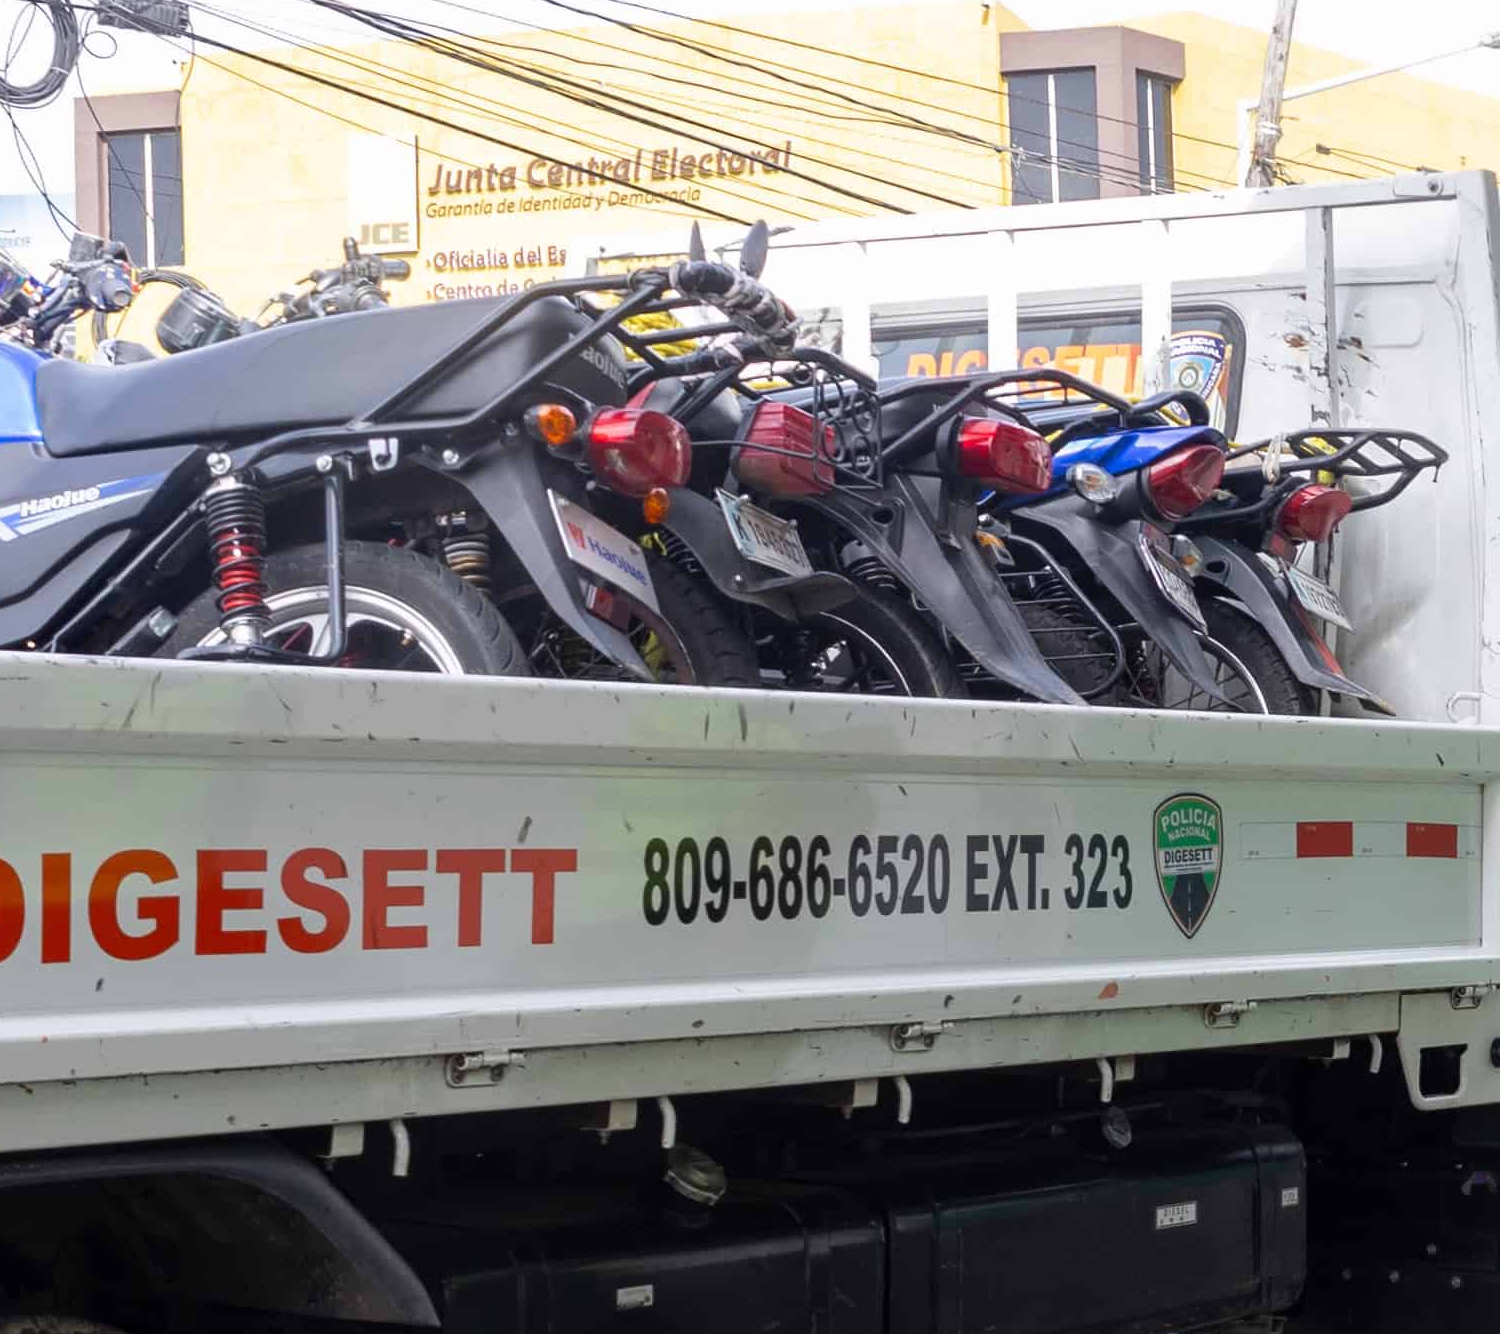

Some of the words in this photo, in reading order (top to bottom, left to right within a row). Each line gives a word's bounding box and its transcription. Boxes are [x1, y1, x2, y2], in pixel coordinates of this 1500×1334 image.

[427, 164, 517, 196] Junta
[527, 148, 643, 187] Central
[651, 140, 791, 180] Electoral
[497, 197, 516, 214] de
[519, 193, 593, 212] Identidad
[607, 186, 701, 207] Democracia
[359, 222, 409, 245] JCE
[514, 246, 543, 268] del
[19, 486, 100, 517] Haojue
[1161, 807, 1216, 833] POLICIA
[1167, 826, 1211, 843] NACIONAL
[1164, 847, 1213, 864] DIGESETT
[643, 834, 951, 927] 809-686-6520
[965, 834, 1050, 912] EXT.
[1063, 832, 1133, 910] 323
